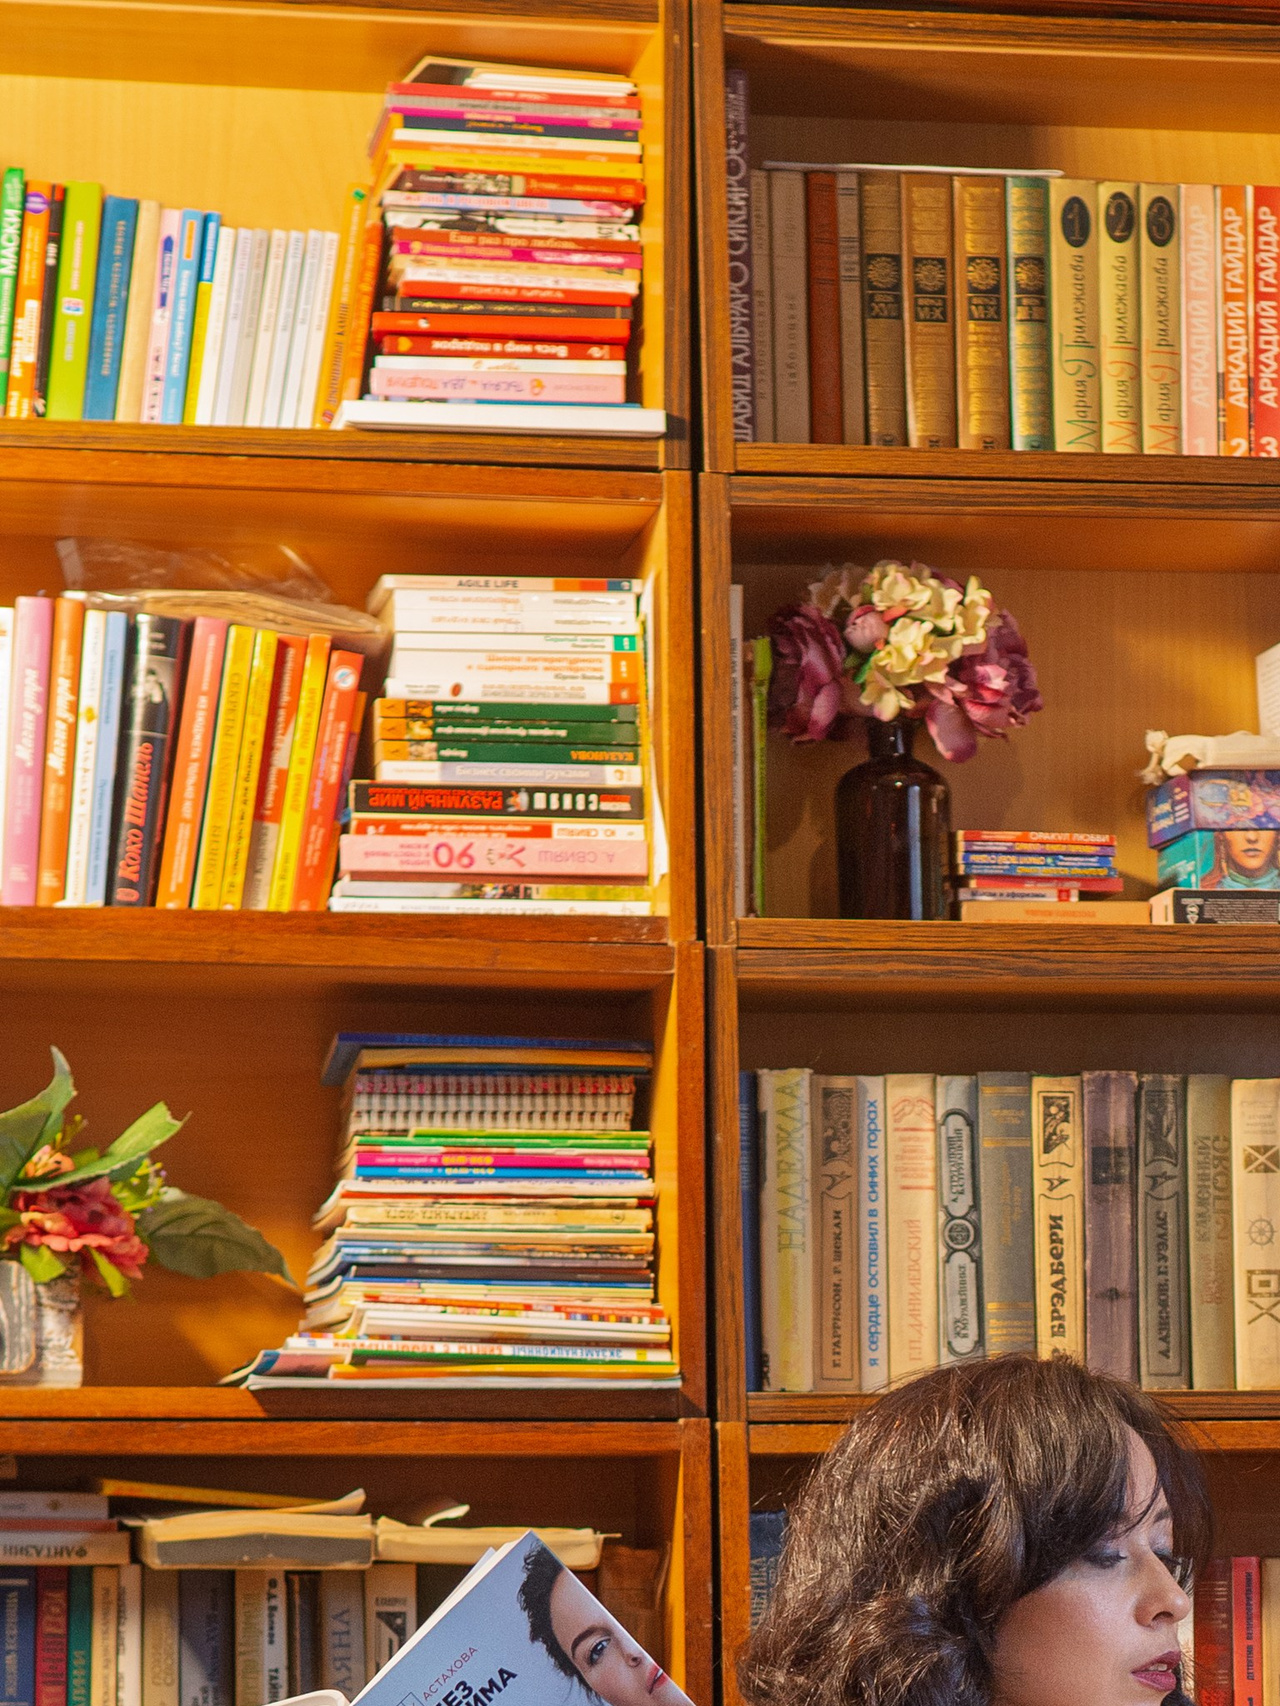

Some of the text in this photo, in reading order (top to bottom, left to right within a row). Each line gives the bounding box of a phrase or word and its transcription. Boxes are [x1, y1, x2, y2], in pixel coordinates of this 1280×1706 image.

[1, 209, 22, 276] МАСКИ
[728, 144, 749, 256] СИКЕЙРОС
[1068, 203, 1084, 240] 1
[1107, 197, 1130, 237] 2
[1150, 205, 1170, 239] 3
[535, 345, 569, 358] Весь
[729, 261, 751, 367] АЛЬФАРО
[1059, 254, 1098, 451] Мария Прилежаева
[1101, 255, 1139, 451] Мария Прилежаева
[1144, 257, 1180, 454] Мария Прилежаева
[1188, 205, 1211, 408] АРКАДИЙ ГАЙДАР
[1223, 207, 1248, 408] АРКАДИЙ ГАЙДАР
[1256, 206, 1279, 408] АРКАДИЙ ГАЙДАР
[733, 374, 752, 441] ДАВИД
[456, 579, 518, 589] AGILE LIFE
[15, 667, 42, 768] Магия утра
[48, 676, 76, 777] Магия утра
[118, 742, 154, 882] Коко Шанель
[368, 793, 503, 810] РАЗУМНЫЙ МИР
[432, 841, 475, 869] 90
[538, 850, 616, 865] А. СВИЯШ
[775, 1076, 809, 1253] НАДЕЖДА
[866, 1099, 883, 1367] я сердце оставил в синих горах
[1048, 1214, 1068, 1338] БРЭДБЕРИ
[512, 1345, 623, 1359] ЭКЗАМЕНАЦИОННЫЕ
[421, 1646, 479, 1701] АСТАХОВА
